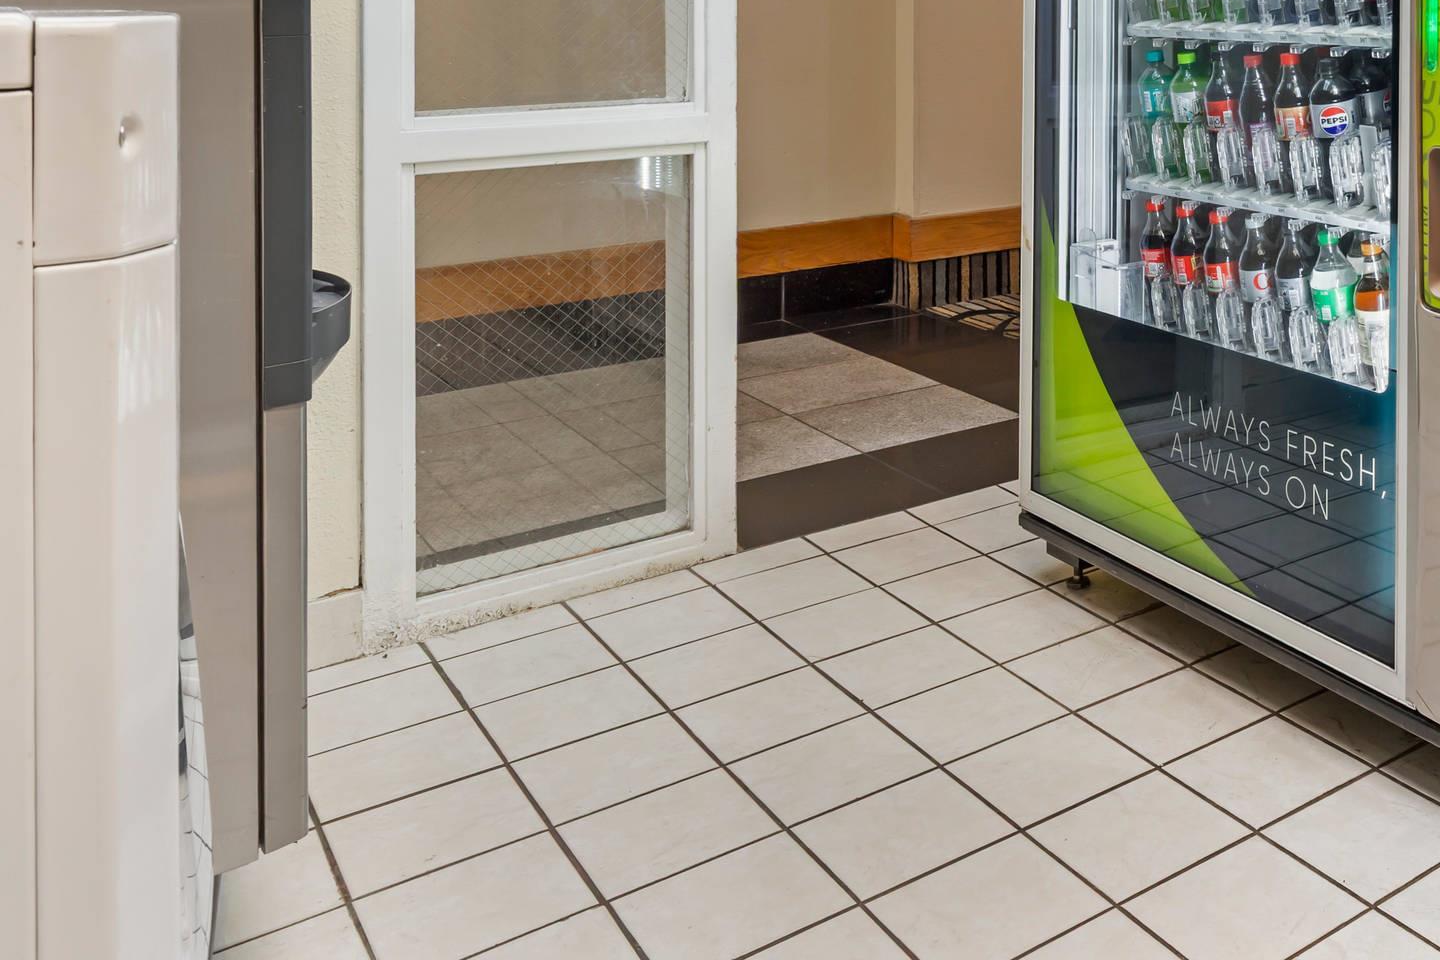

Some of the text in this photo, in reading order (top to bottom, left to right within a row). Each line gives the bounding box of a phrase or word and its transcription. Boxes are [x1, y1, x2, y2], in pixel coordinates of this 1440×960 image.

[1320, 116, 1348, 127] PEPSI
[1170, 391, 1387, 500] ALWAYS FRESH,
[1170, 431, 1329, 521] ALWAYS ON
